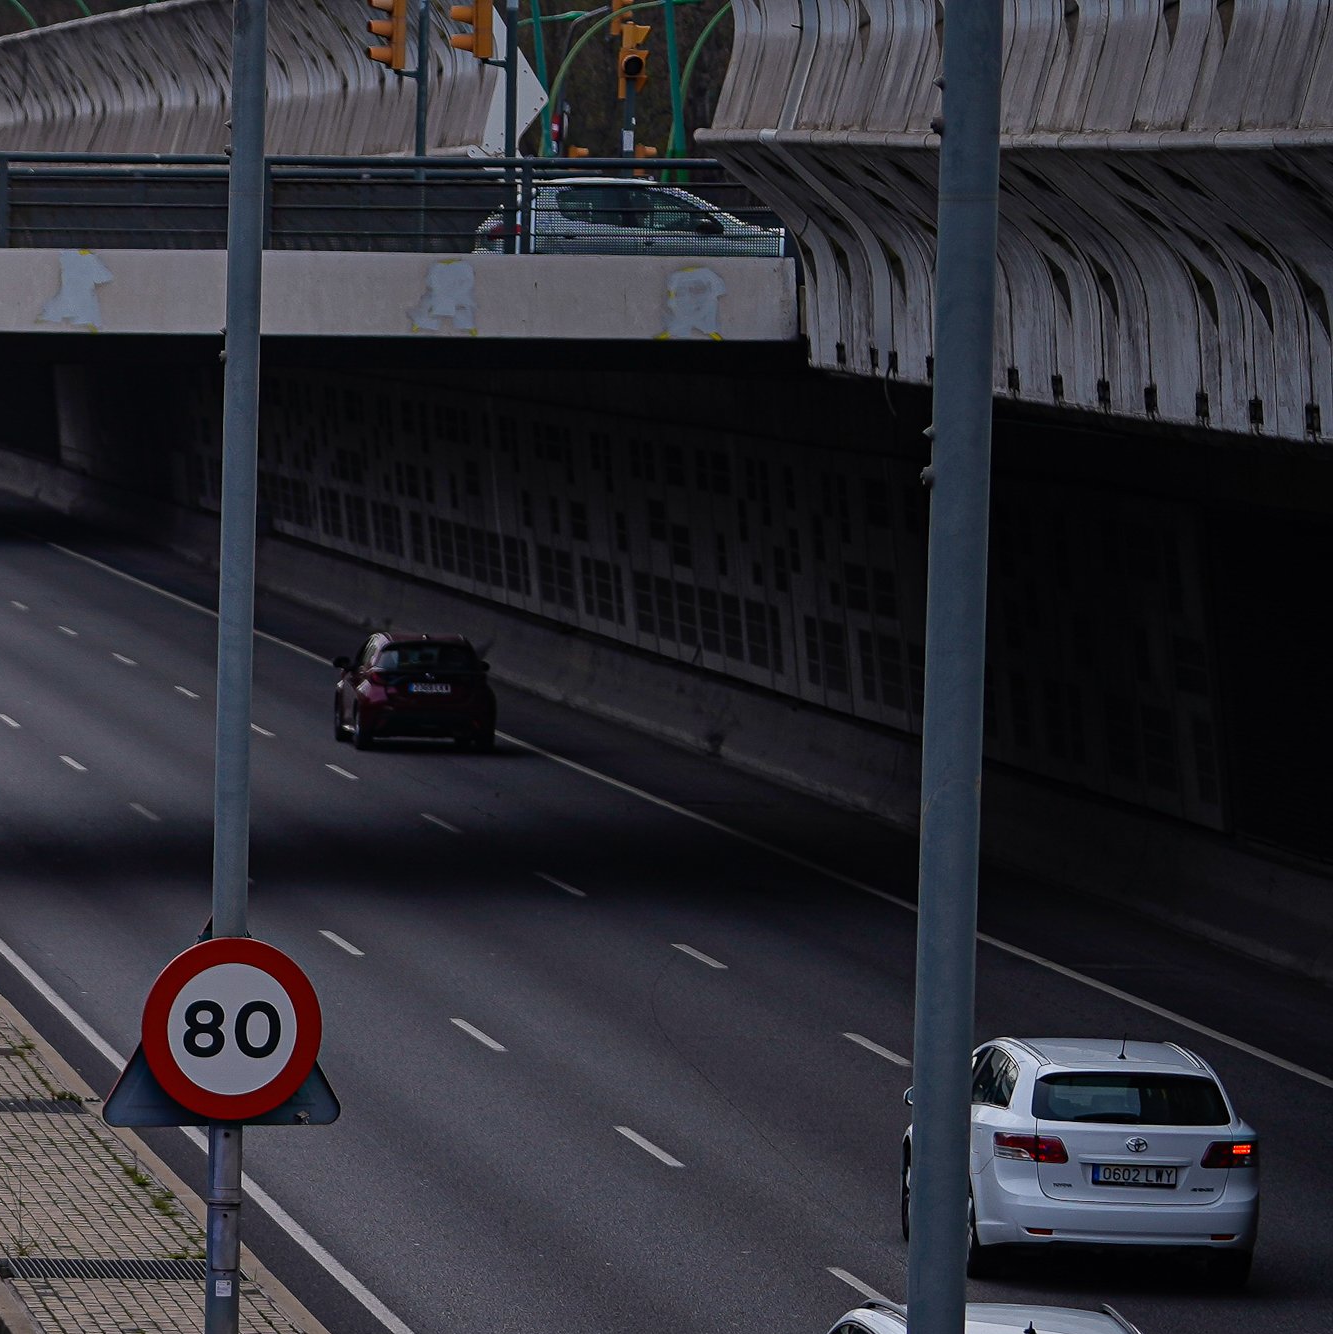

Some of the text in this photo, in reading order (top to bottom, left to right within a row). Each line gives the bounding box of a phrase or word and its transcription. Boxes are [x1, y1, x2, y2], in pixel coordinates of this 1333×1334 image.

[182, 1000, 280, 1058] 80
[1103, 1167, 1173, 1183] 0602 LWY
